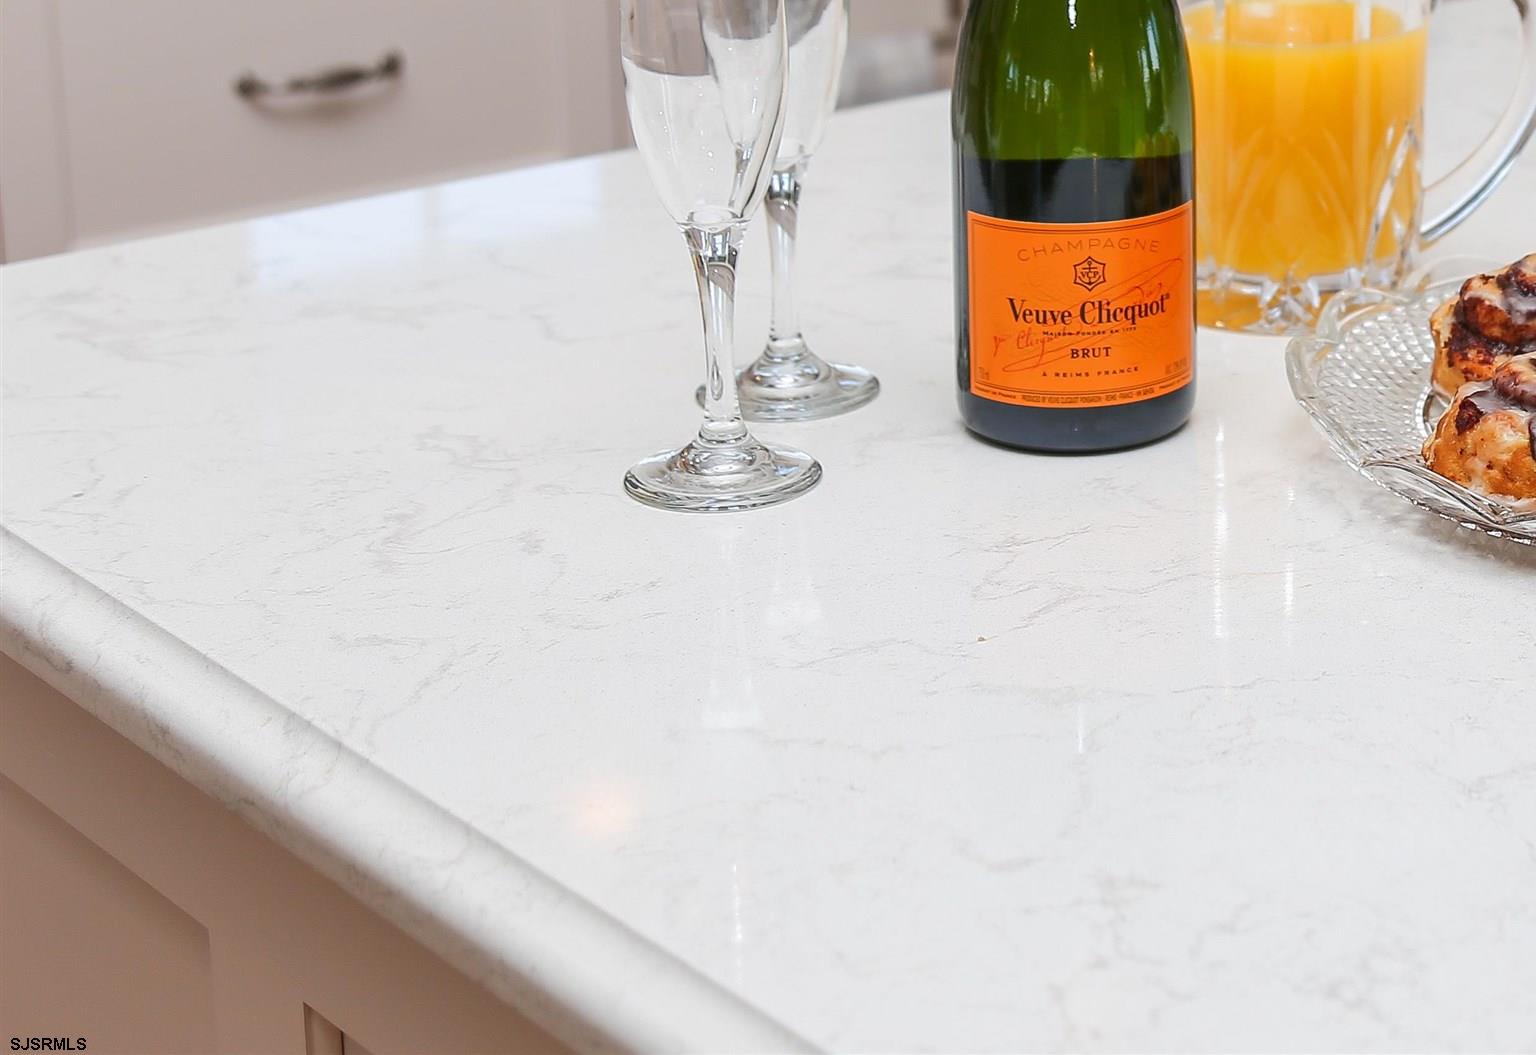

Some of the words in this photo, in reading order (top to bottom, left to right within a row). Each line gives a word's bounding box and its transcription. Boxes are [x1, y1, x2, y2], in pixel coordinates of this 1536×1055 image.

[1017, 238, 1160, 262] CHAMPAGNE
[1006, 297, 1072, 326] Veuve
[1080, 293, 1166, 325] Clicquot
[1071, 346, 1112, 359] BRUT
[1097, 366, 1139, 376] FRANCE
